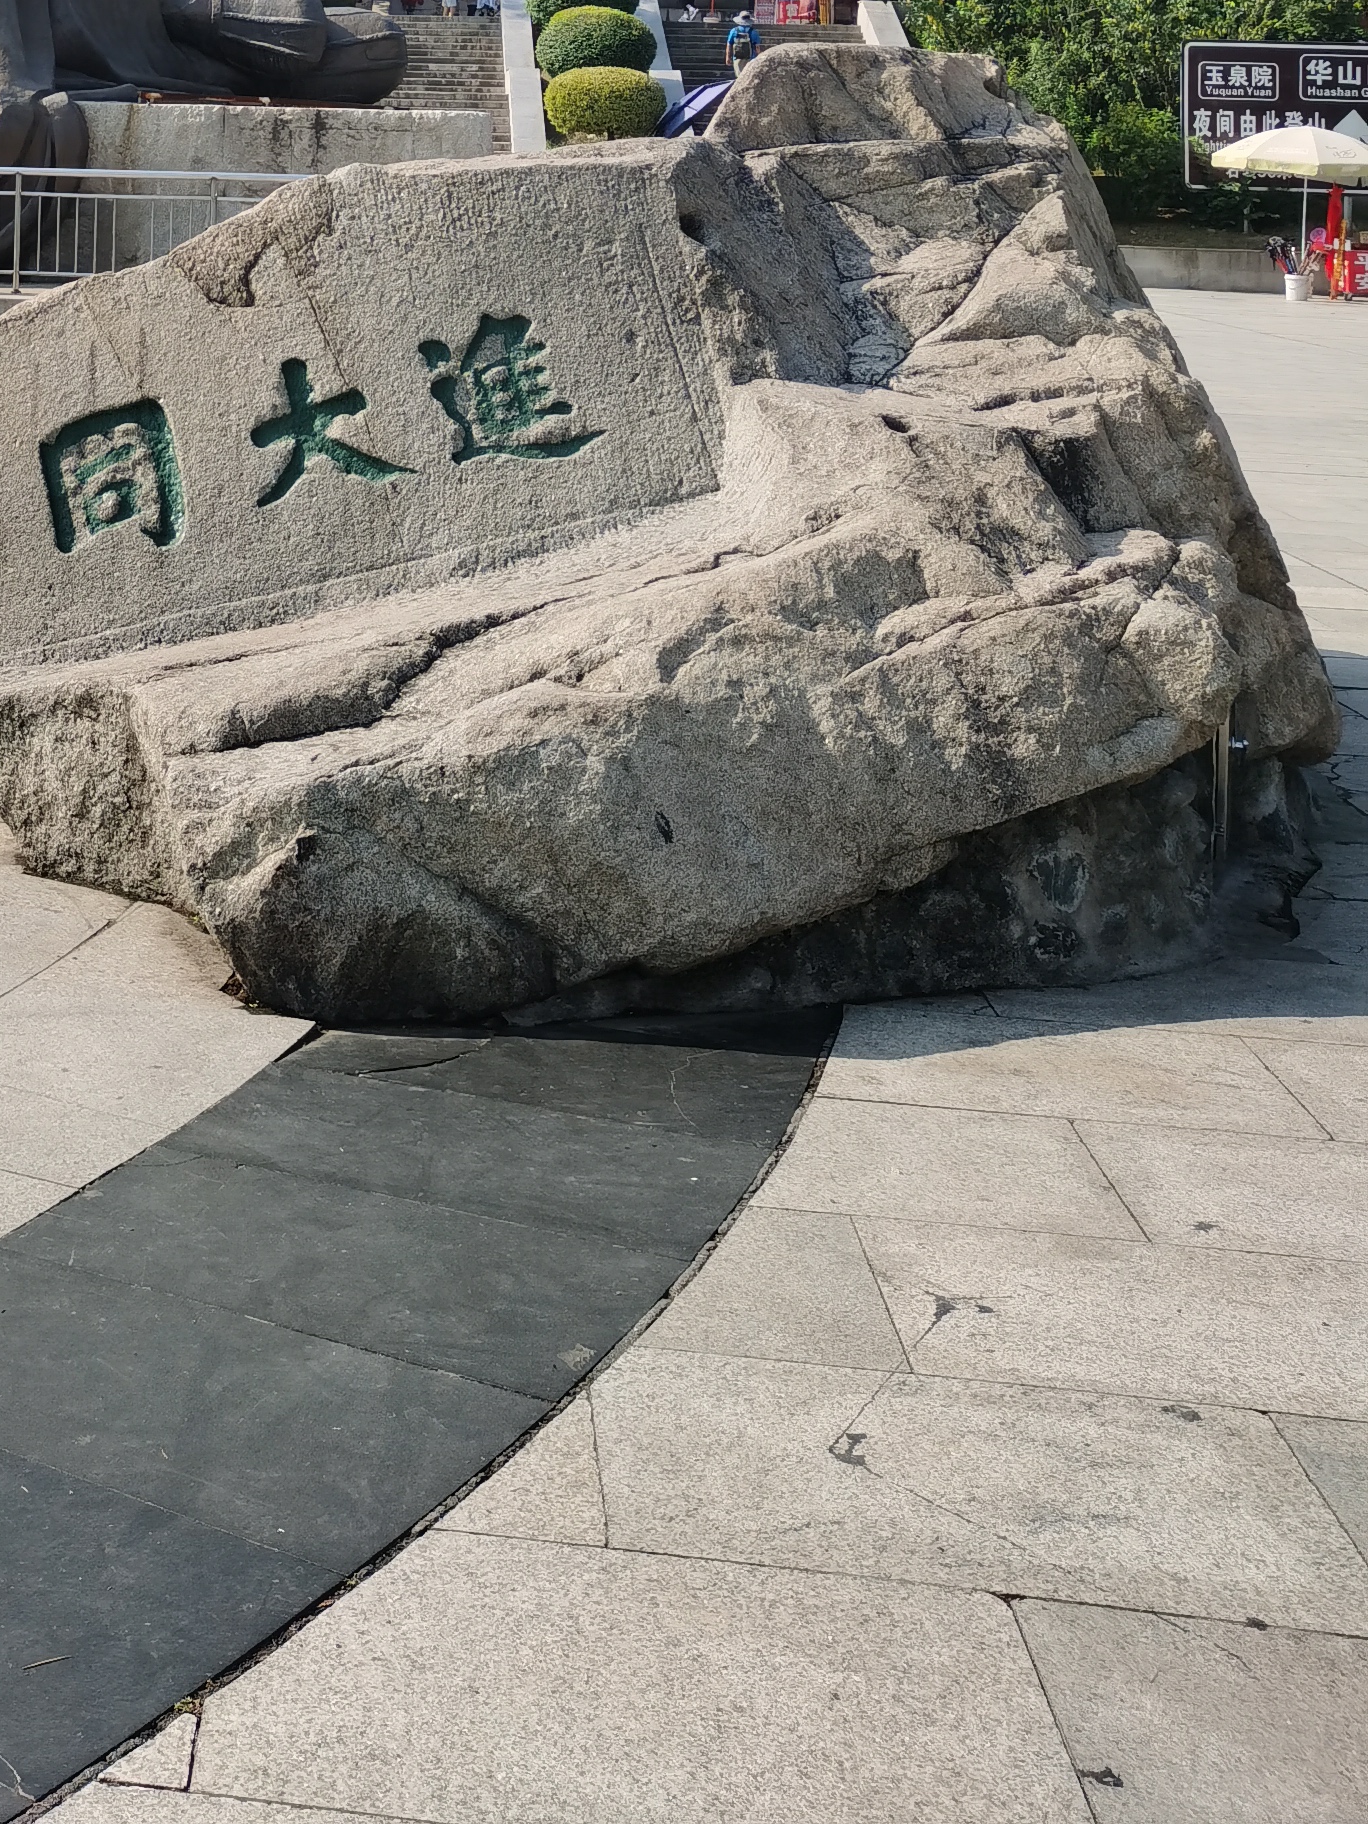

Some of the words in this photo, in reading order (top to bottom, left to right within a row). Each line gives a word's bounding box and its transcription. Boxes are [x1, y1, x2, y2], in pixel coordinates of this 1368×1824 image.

[1203, 65, 1273, 87] 玉泉院
[1306, 59, 1368, 86] 华山
[1205, 86, 1244, 97] Yuquan
[1246, 87, 1272, 97] Yuan
[1307, 86, 1359, 97] Huashan
